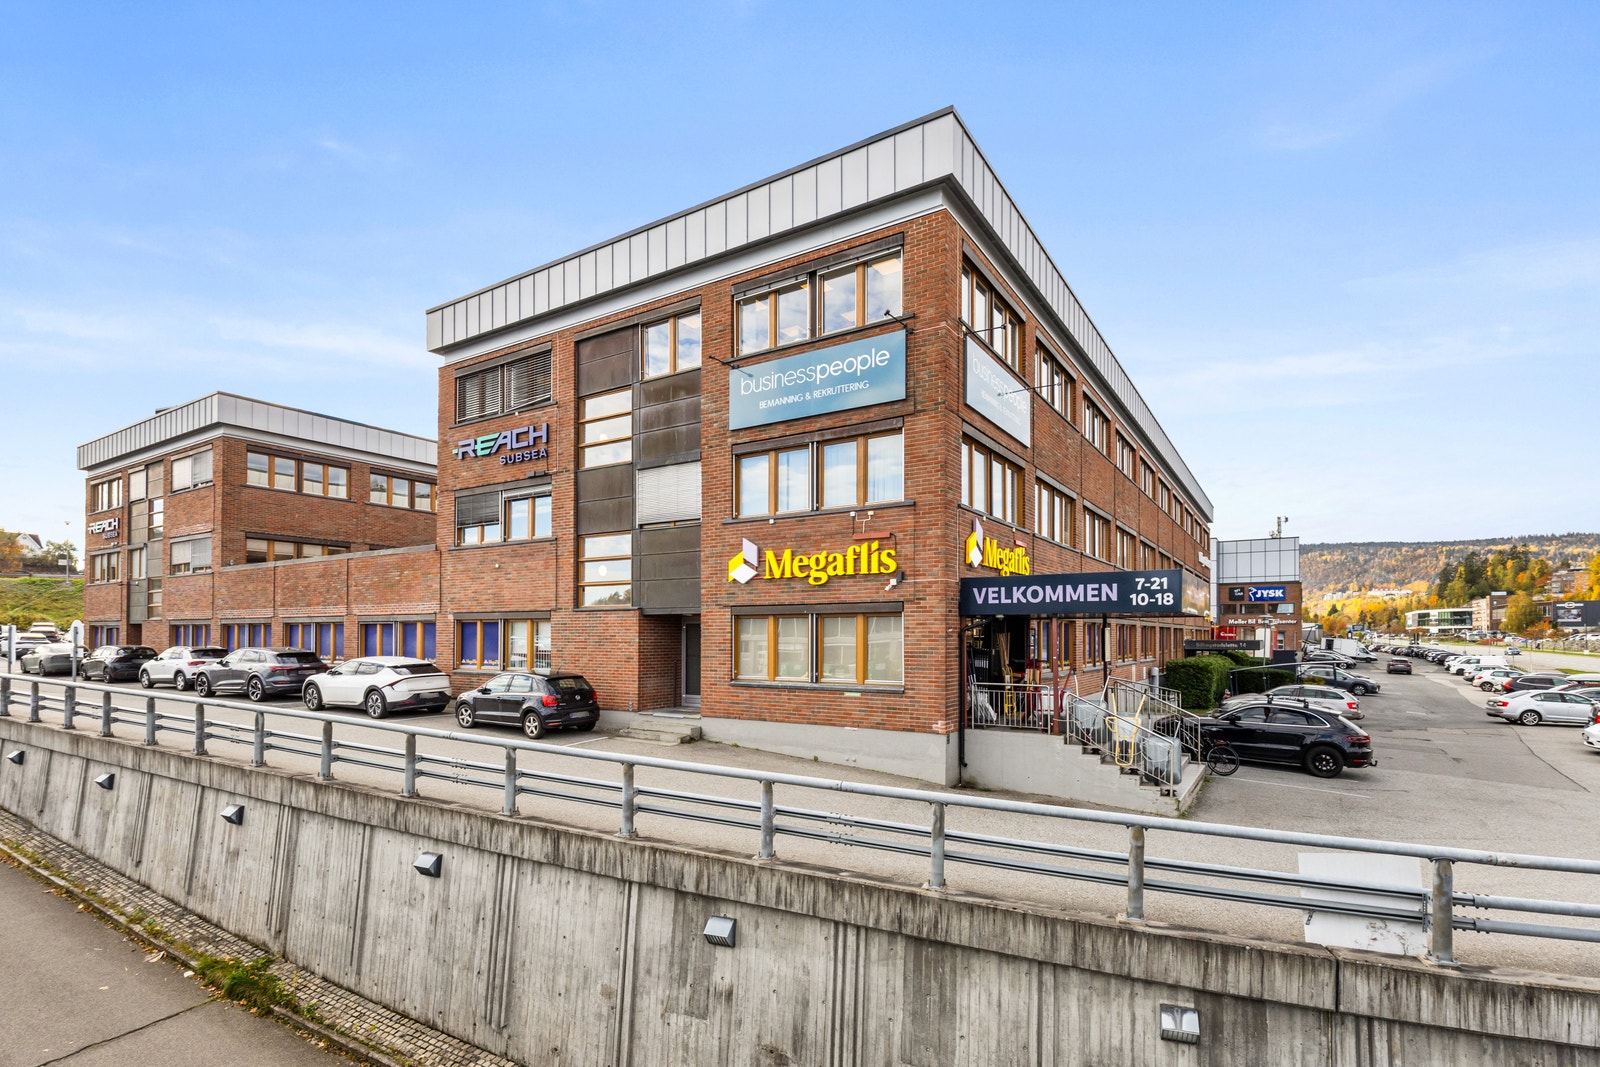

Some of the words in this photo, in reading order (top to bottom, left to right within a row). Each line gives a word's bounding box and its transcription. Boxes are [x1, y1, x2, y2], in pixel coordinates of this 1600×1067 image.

[741, 348, 890, 396] businesspeople
[759, 393, 803, 409] BEMANNING
[813, 380, 870, 398] REKRUTTERING
[455, 423, 548, 459] REACH
[499, 448, 547, 465] SUBSEA
[88, 517, 119, 534] REACH
[764, 540, 897, 586] Megaflis
[1135, 577, 1168, 590] 7-21
[973, 583, 1118, 605] VELKOMMEN
[1129, 592, 1174, 606] 10-18
[1255, 589, 1284, 598] JYSK
